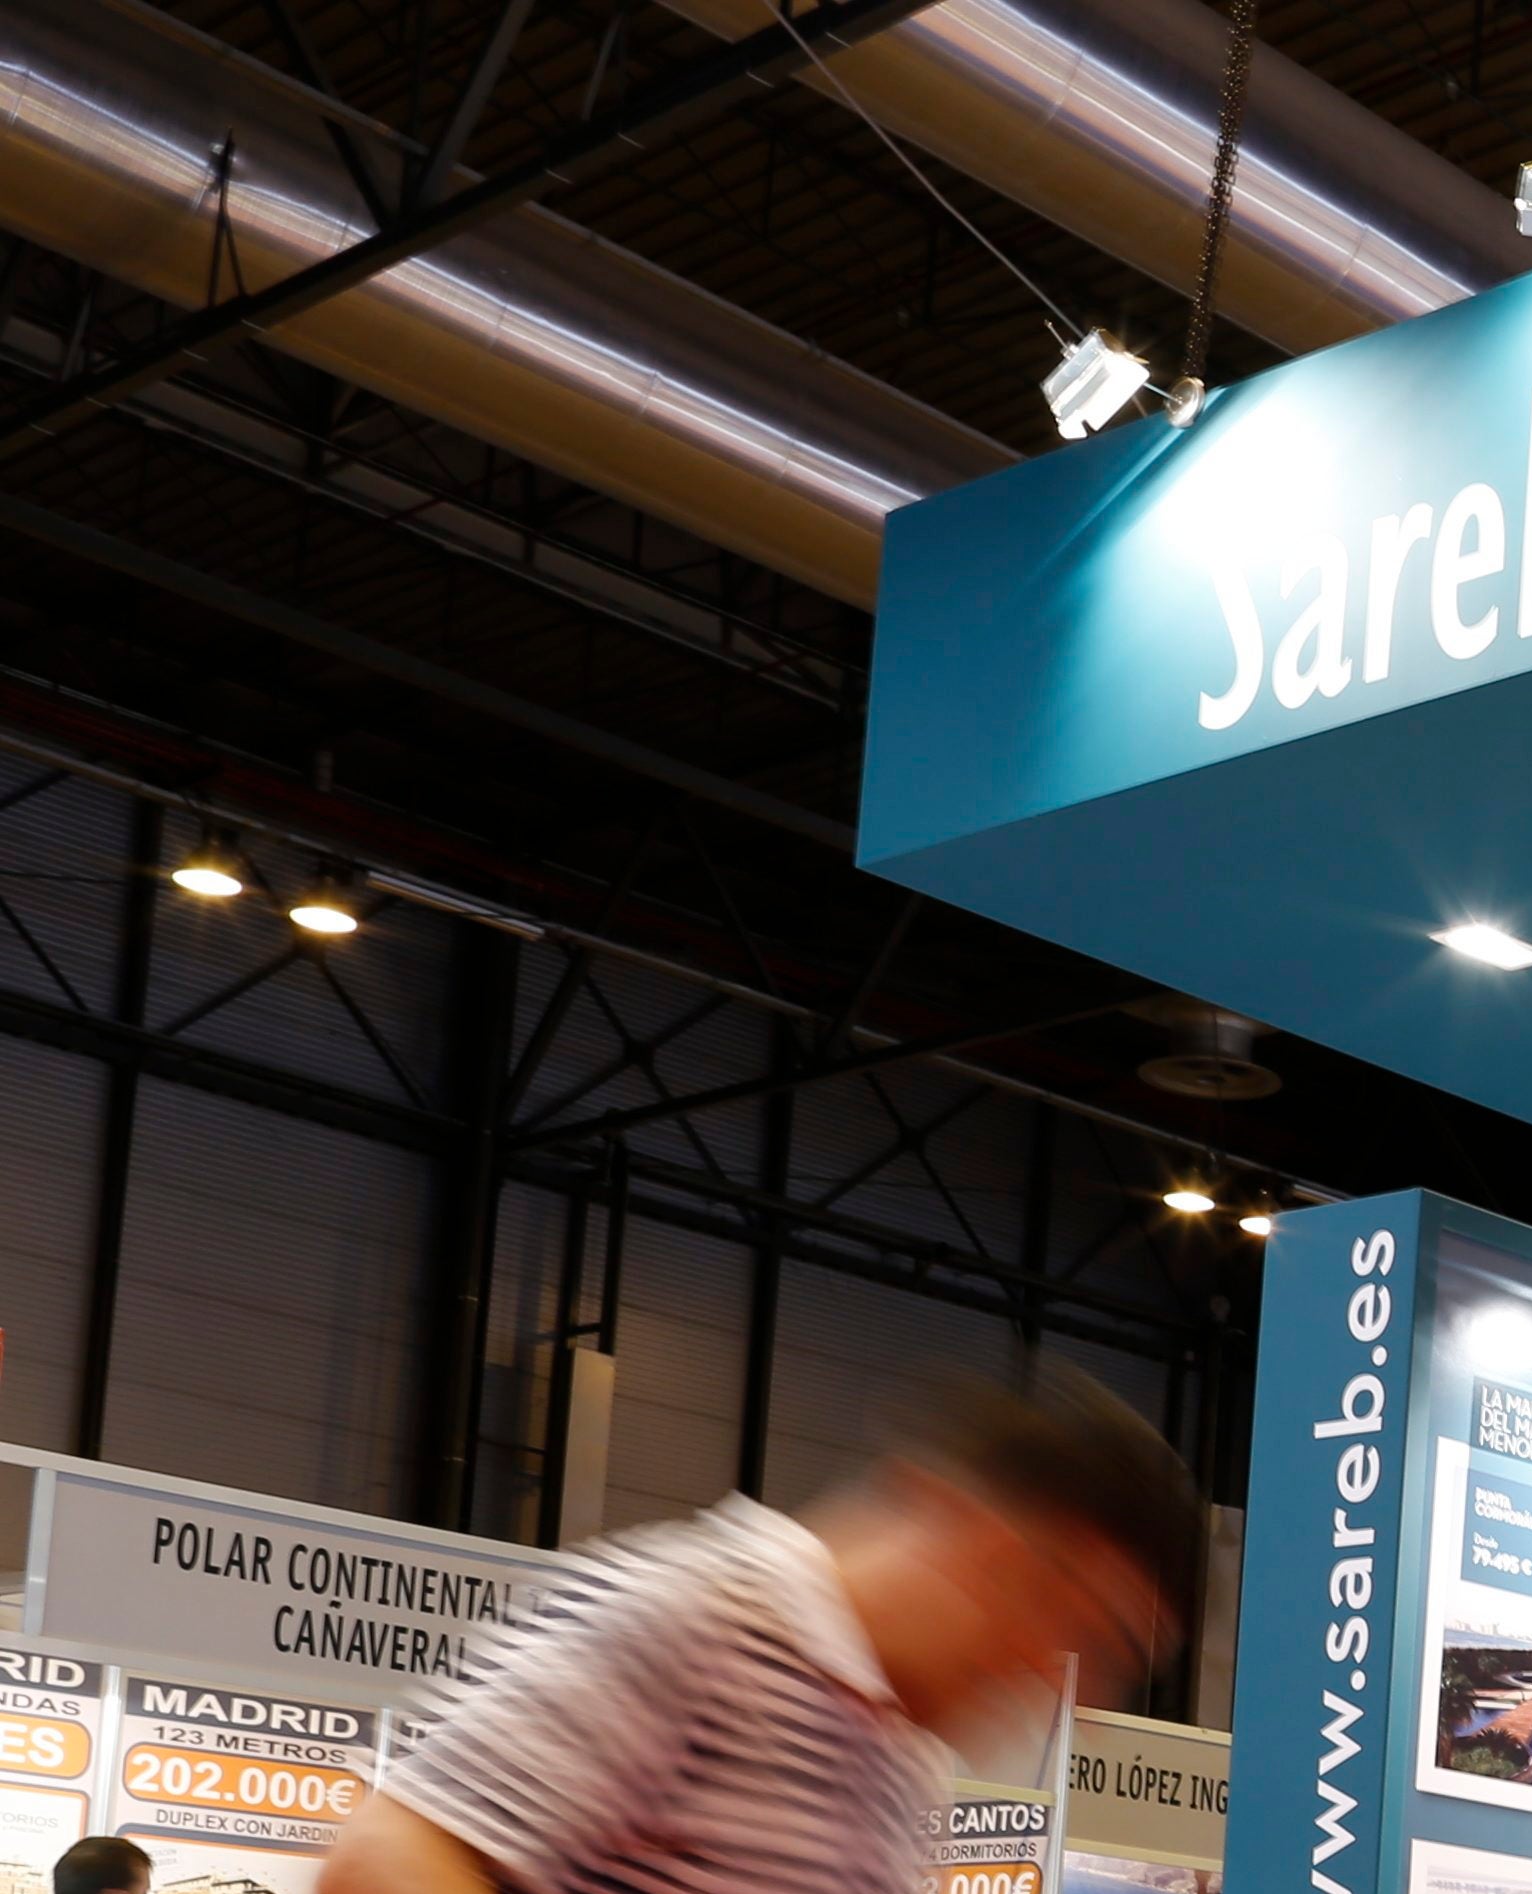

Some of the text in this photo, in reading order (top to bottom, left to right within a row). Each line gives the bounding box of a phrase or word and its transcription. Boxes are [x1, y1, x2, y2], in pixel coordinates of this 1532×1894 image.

[1482, 1386, 1502, 1411] LA
[1480, 1405, 1511, 1435] DEL
[1475, 1487, 1512, 1510] PUNTA
[153, 1517, 272, 1585] POLAR
[289, 1543, 518, 1628] CONTINENTAL
[274, 1601, 472, 1682] CAÑAVERAL
[143, 1684, 359, 1739] MADRID
[153, 1725, 347, 1765] 123 METROS
[129, 1752, 357, 1816] 202.000€
[1116, 1755, 1184, 1807] LÓPEZ
[156, 1808, 229, 1832] DUPLEX
[234, 1818, 273, 1837] CON
[950, 1804, 1045, 1834] CANTOS
[941, 1843, 1037, 1862] DORMITORIOS
